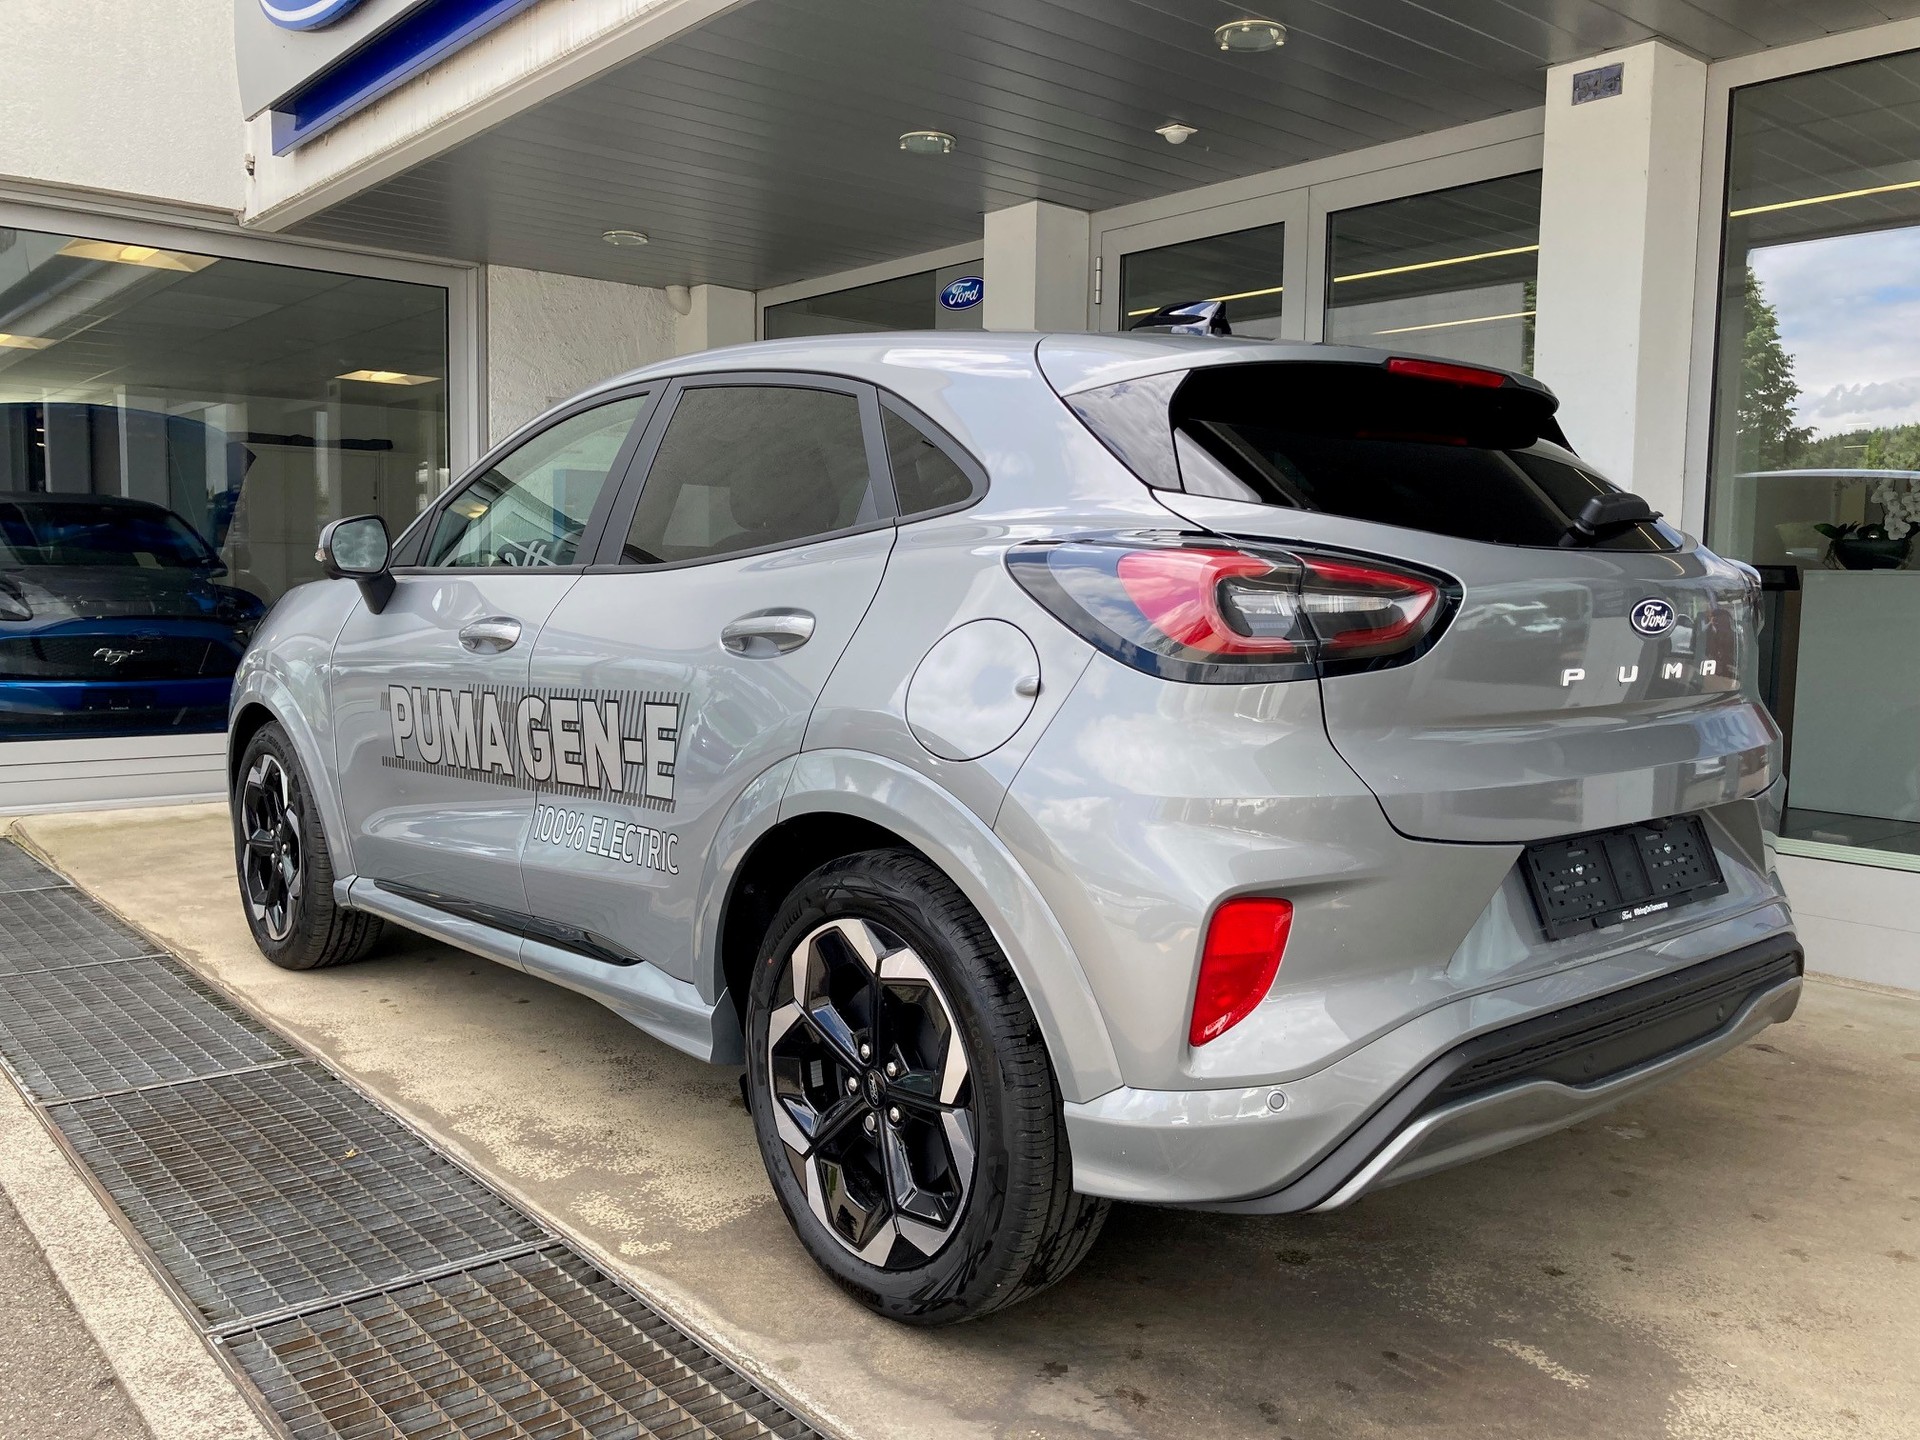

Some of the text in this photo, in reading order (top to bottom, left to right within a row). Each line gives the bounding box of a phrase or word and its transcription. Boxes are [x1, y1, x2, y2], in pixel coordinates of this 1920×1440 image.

[948, 281, 980, 305] Ford
[1640, 604, 1668, 628] Ford
[1560, 659, 1717, 687] PUMA
[388, 684, 516, 777] PUMA
[516, 694, 680, 801] GEN-E
[533, 803, 680, 875] 100% ELECTRIC
